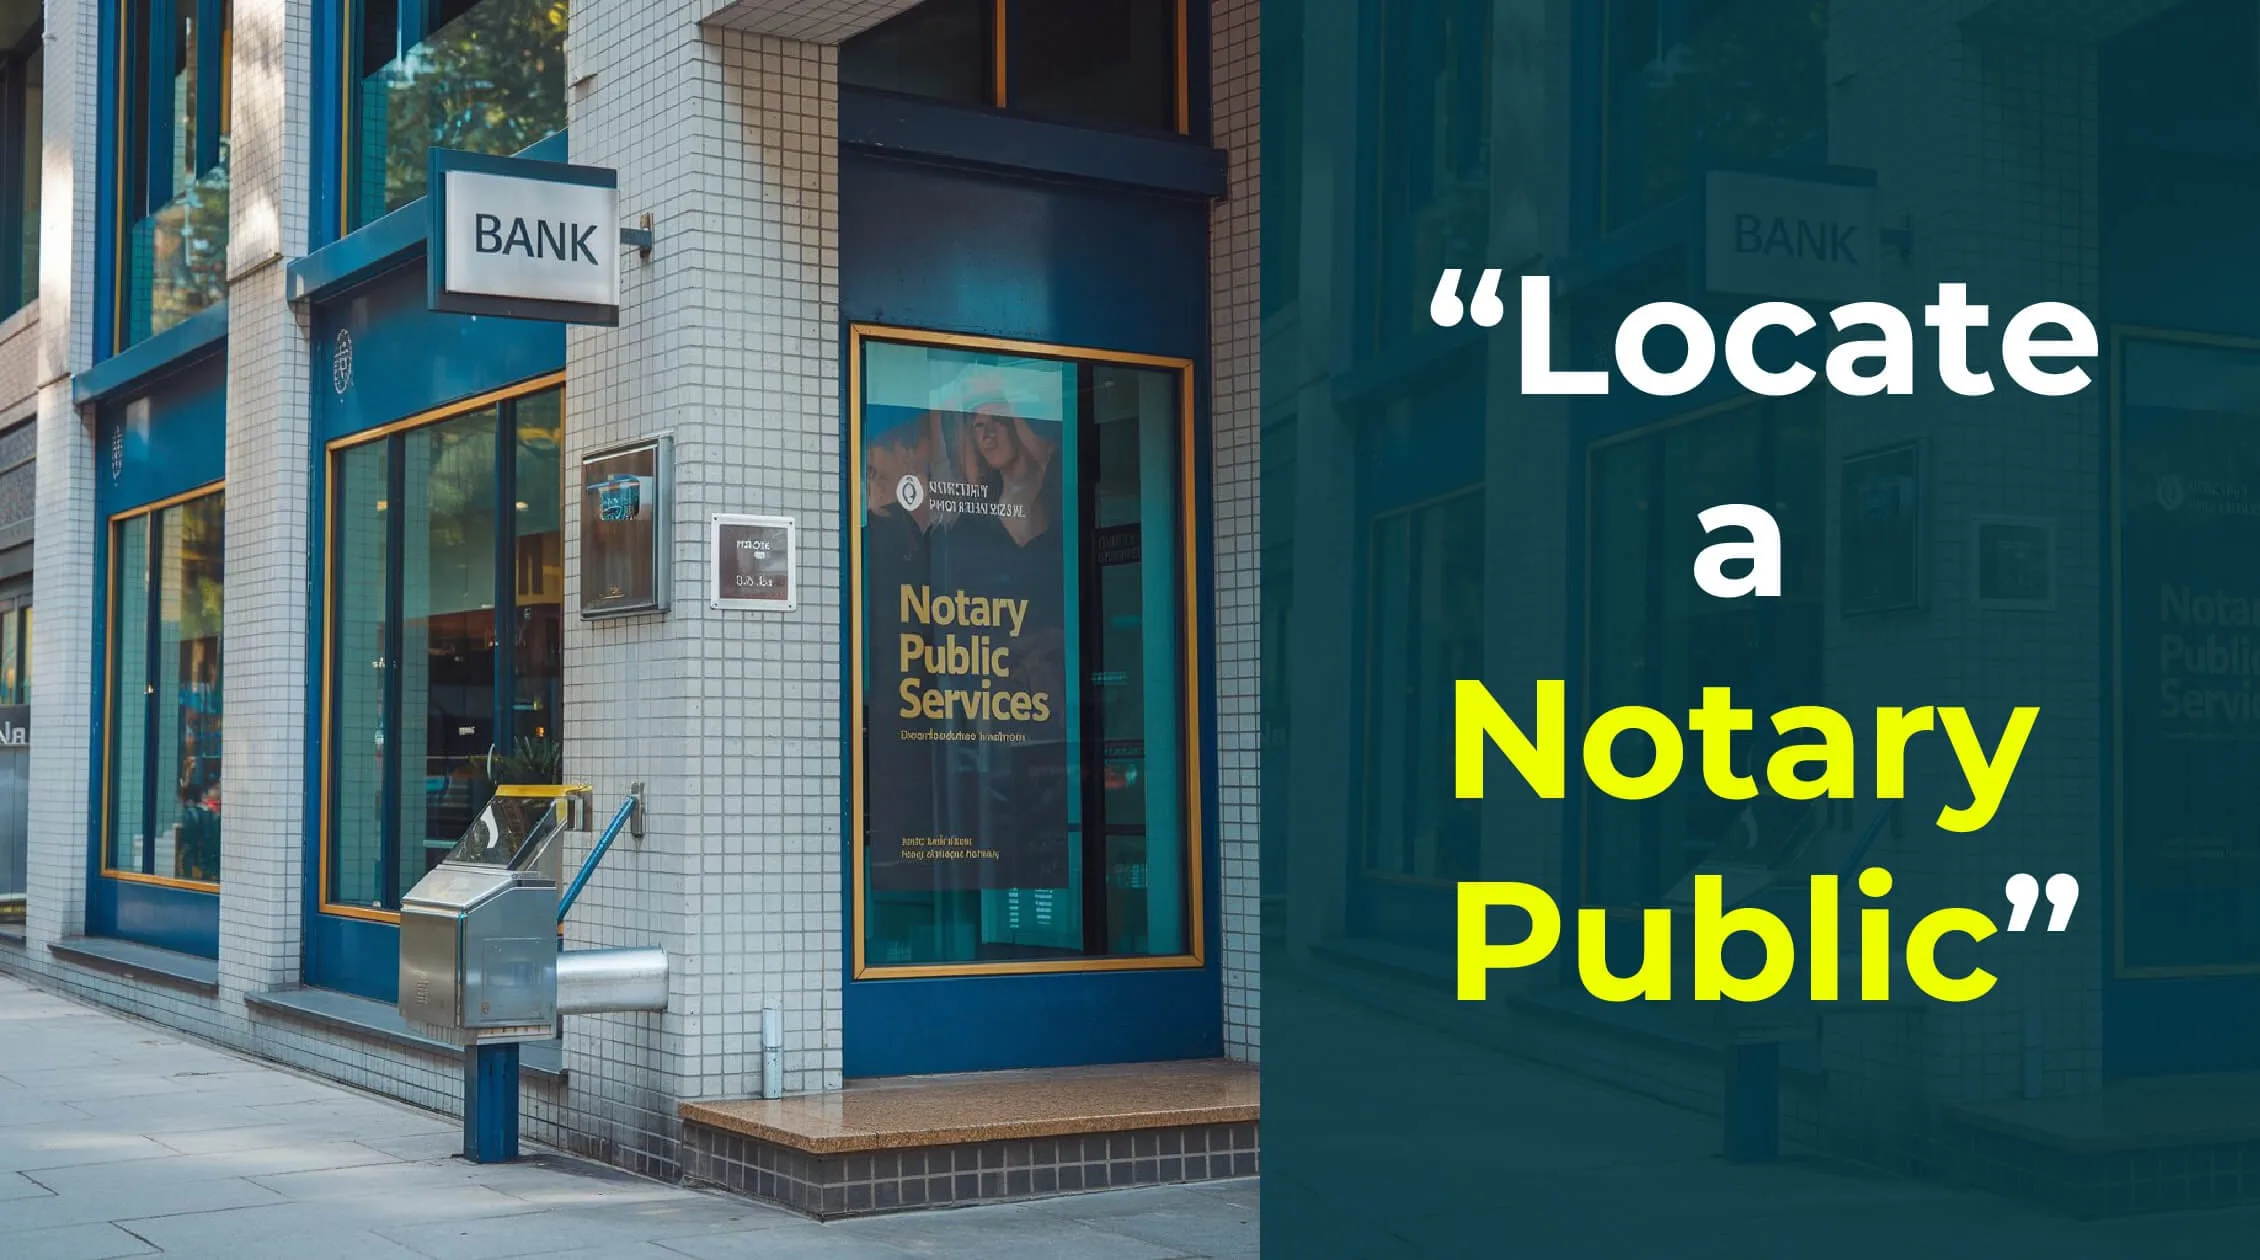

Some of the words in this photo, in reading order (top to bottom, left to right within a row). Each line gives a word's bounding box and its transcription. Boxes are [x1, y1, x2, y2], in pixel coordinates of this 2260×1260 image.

[475, 213, 599, 266] BANK
[1735, 213, 1858, 265] BANK
[900, 584, 1028, 638] Notary
[900, 633, 1010, 677] Public
[899, 677, 1050, 721] Services
